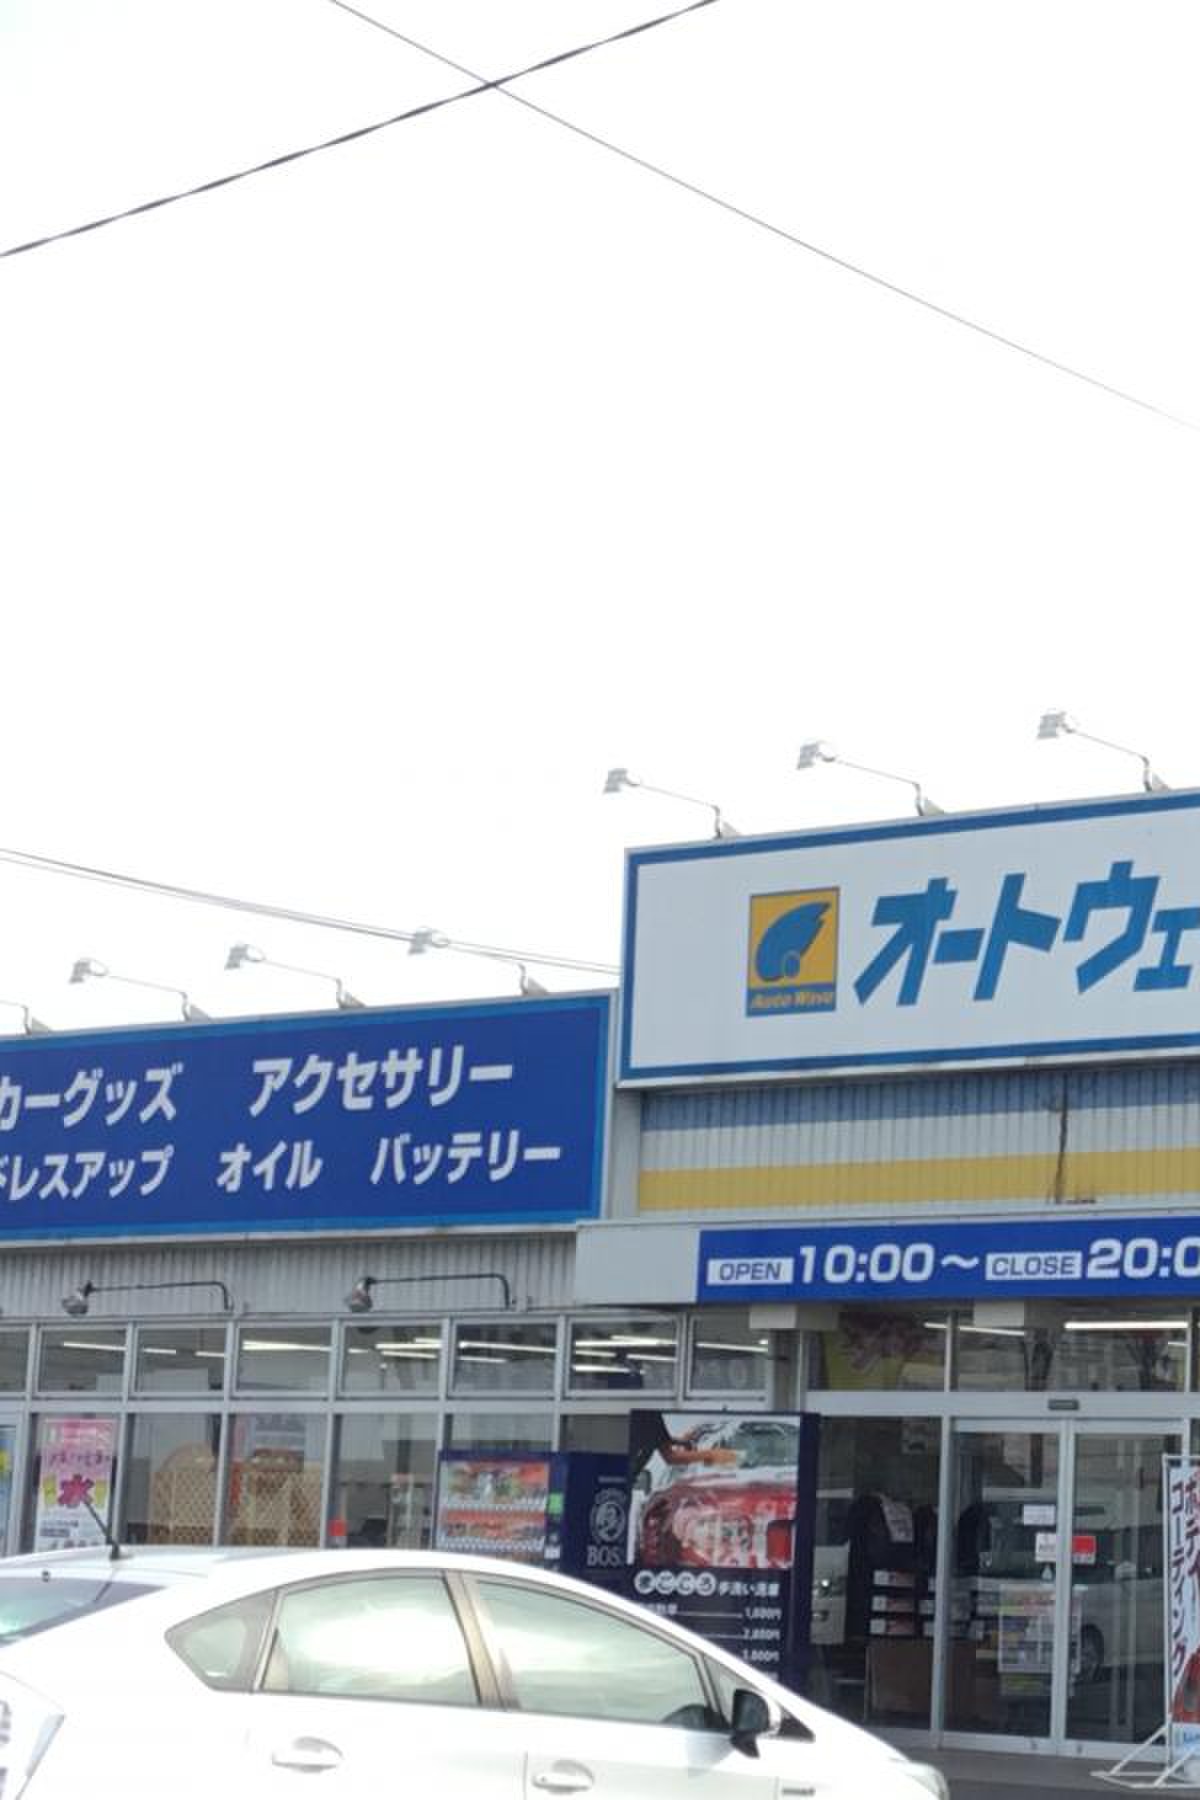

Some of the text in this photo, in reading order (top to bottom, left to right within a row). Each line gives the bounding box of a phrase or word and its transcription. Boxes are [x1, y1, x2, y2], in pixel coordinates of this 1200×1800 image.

[0, 1045, 513, 1131] カーグッズ アクセサリー
[216, 1140, 322, 1192] オイル
[370, 1130, 562, 1184] バッテリー
[718, 1262, 782, 1281] OPEN
[991, 1256, 1075, 1276] CLOSE
